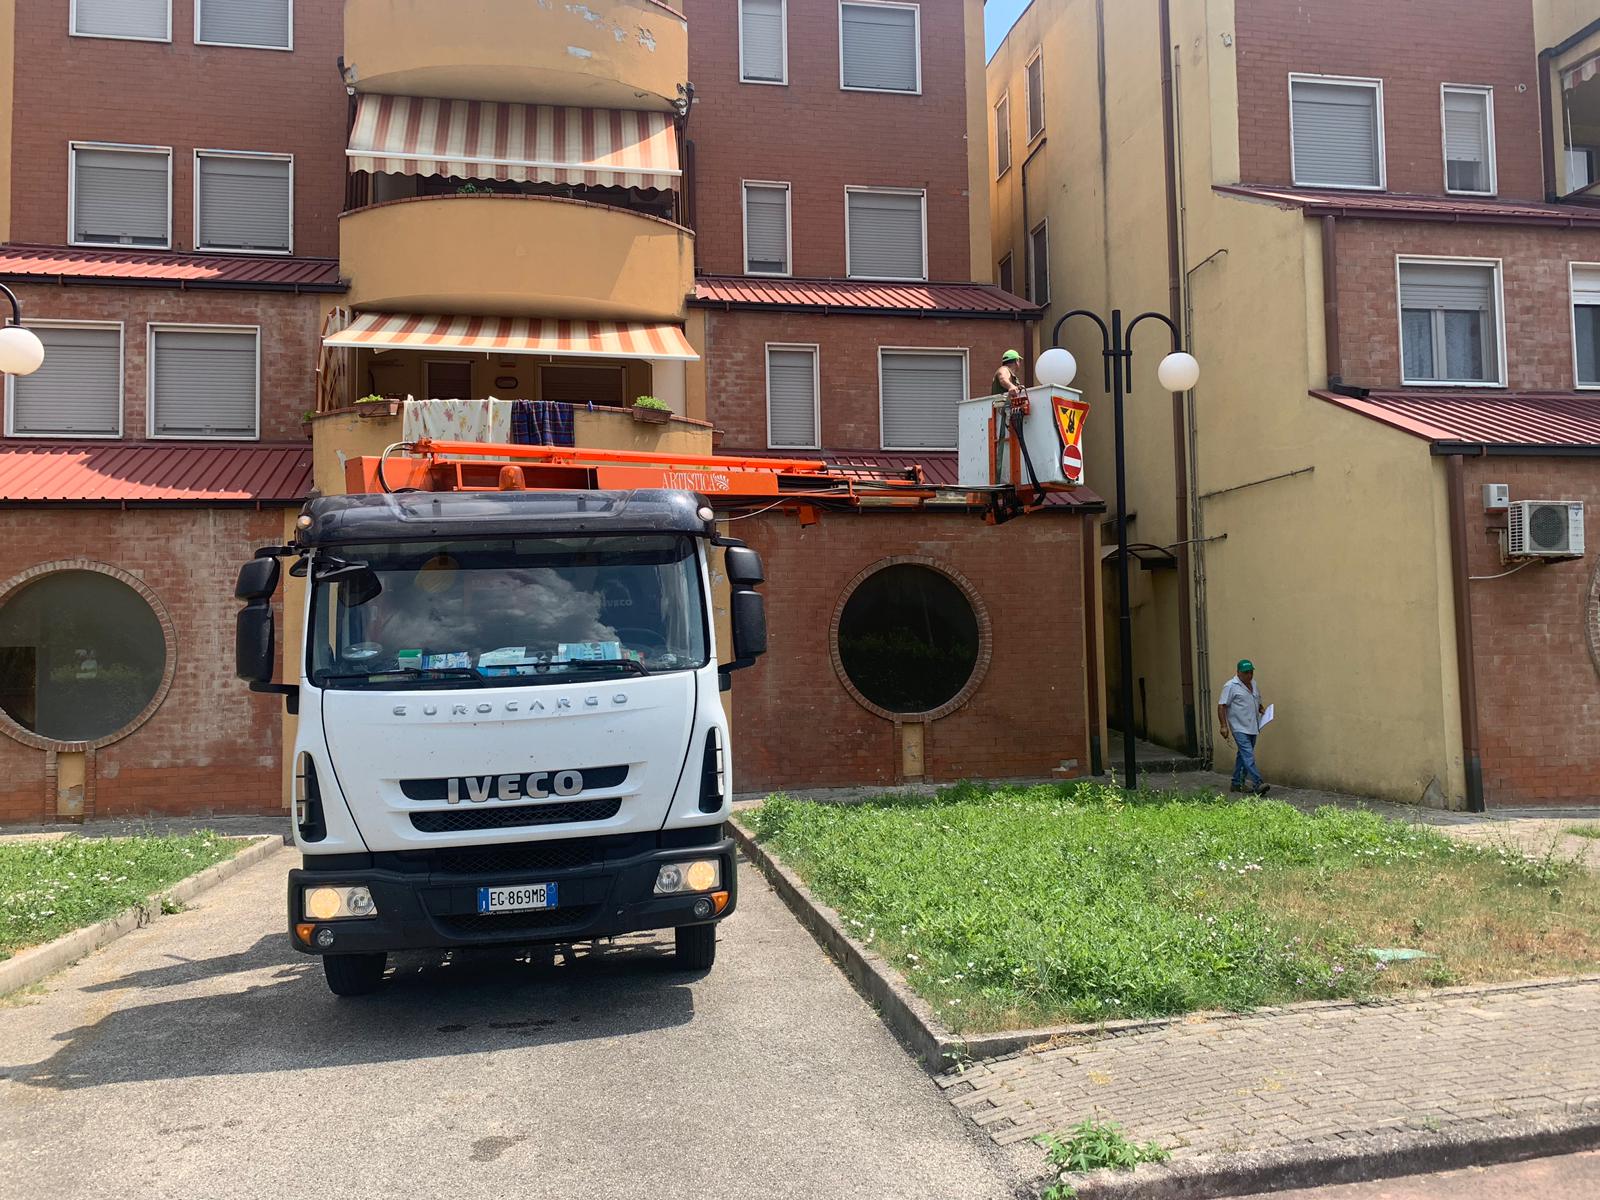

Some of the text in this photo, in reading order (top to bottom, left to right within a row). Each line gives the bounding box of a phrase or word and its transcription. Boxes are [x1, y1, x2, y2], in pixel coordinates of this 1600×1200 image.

[662, 472, 719, 491] ARTISTICA
[392, 693, 628, 717] EUROCARGO
[447, 770, 584, 804] IVECO
